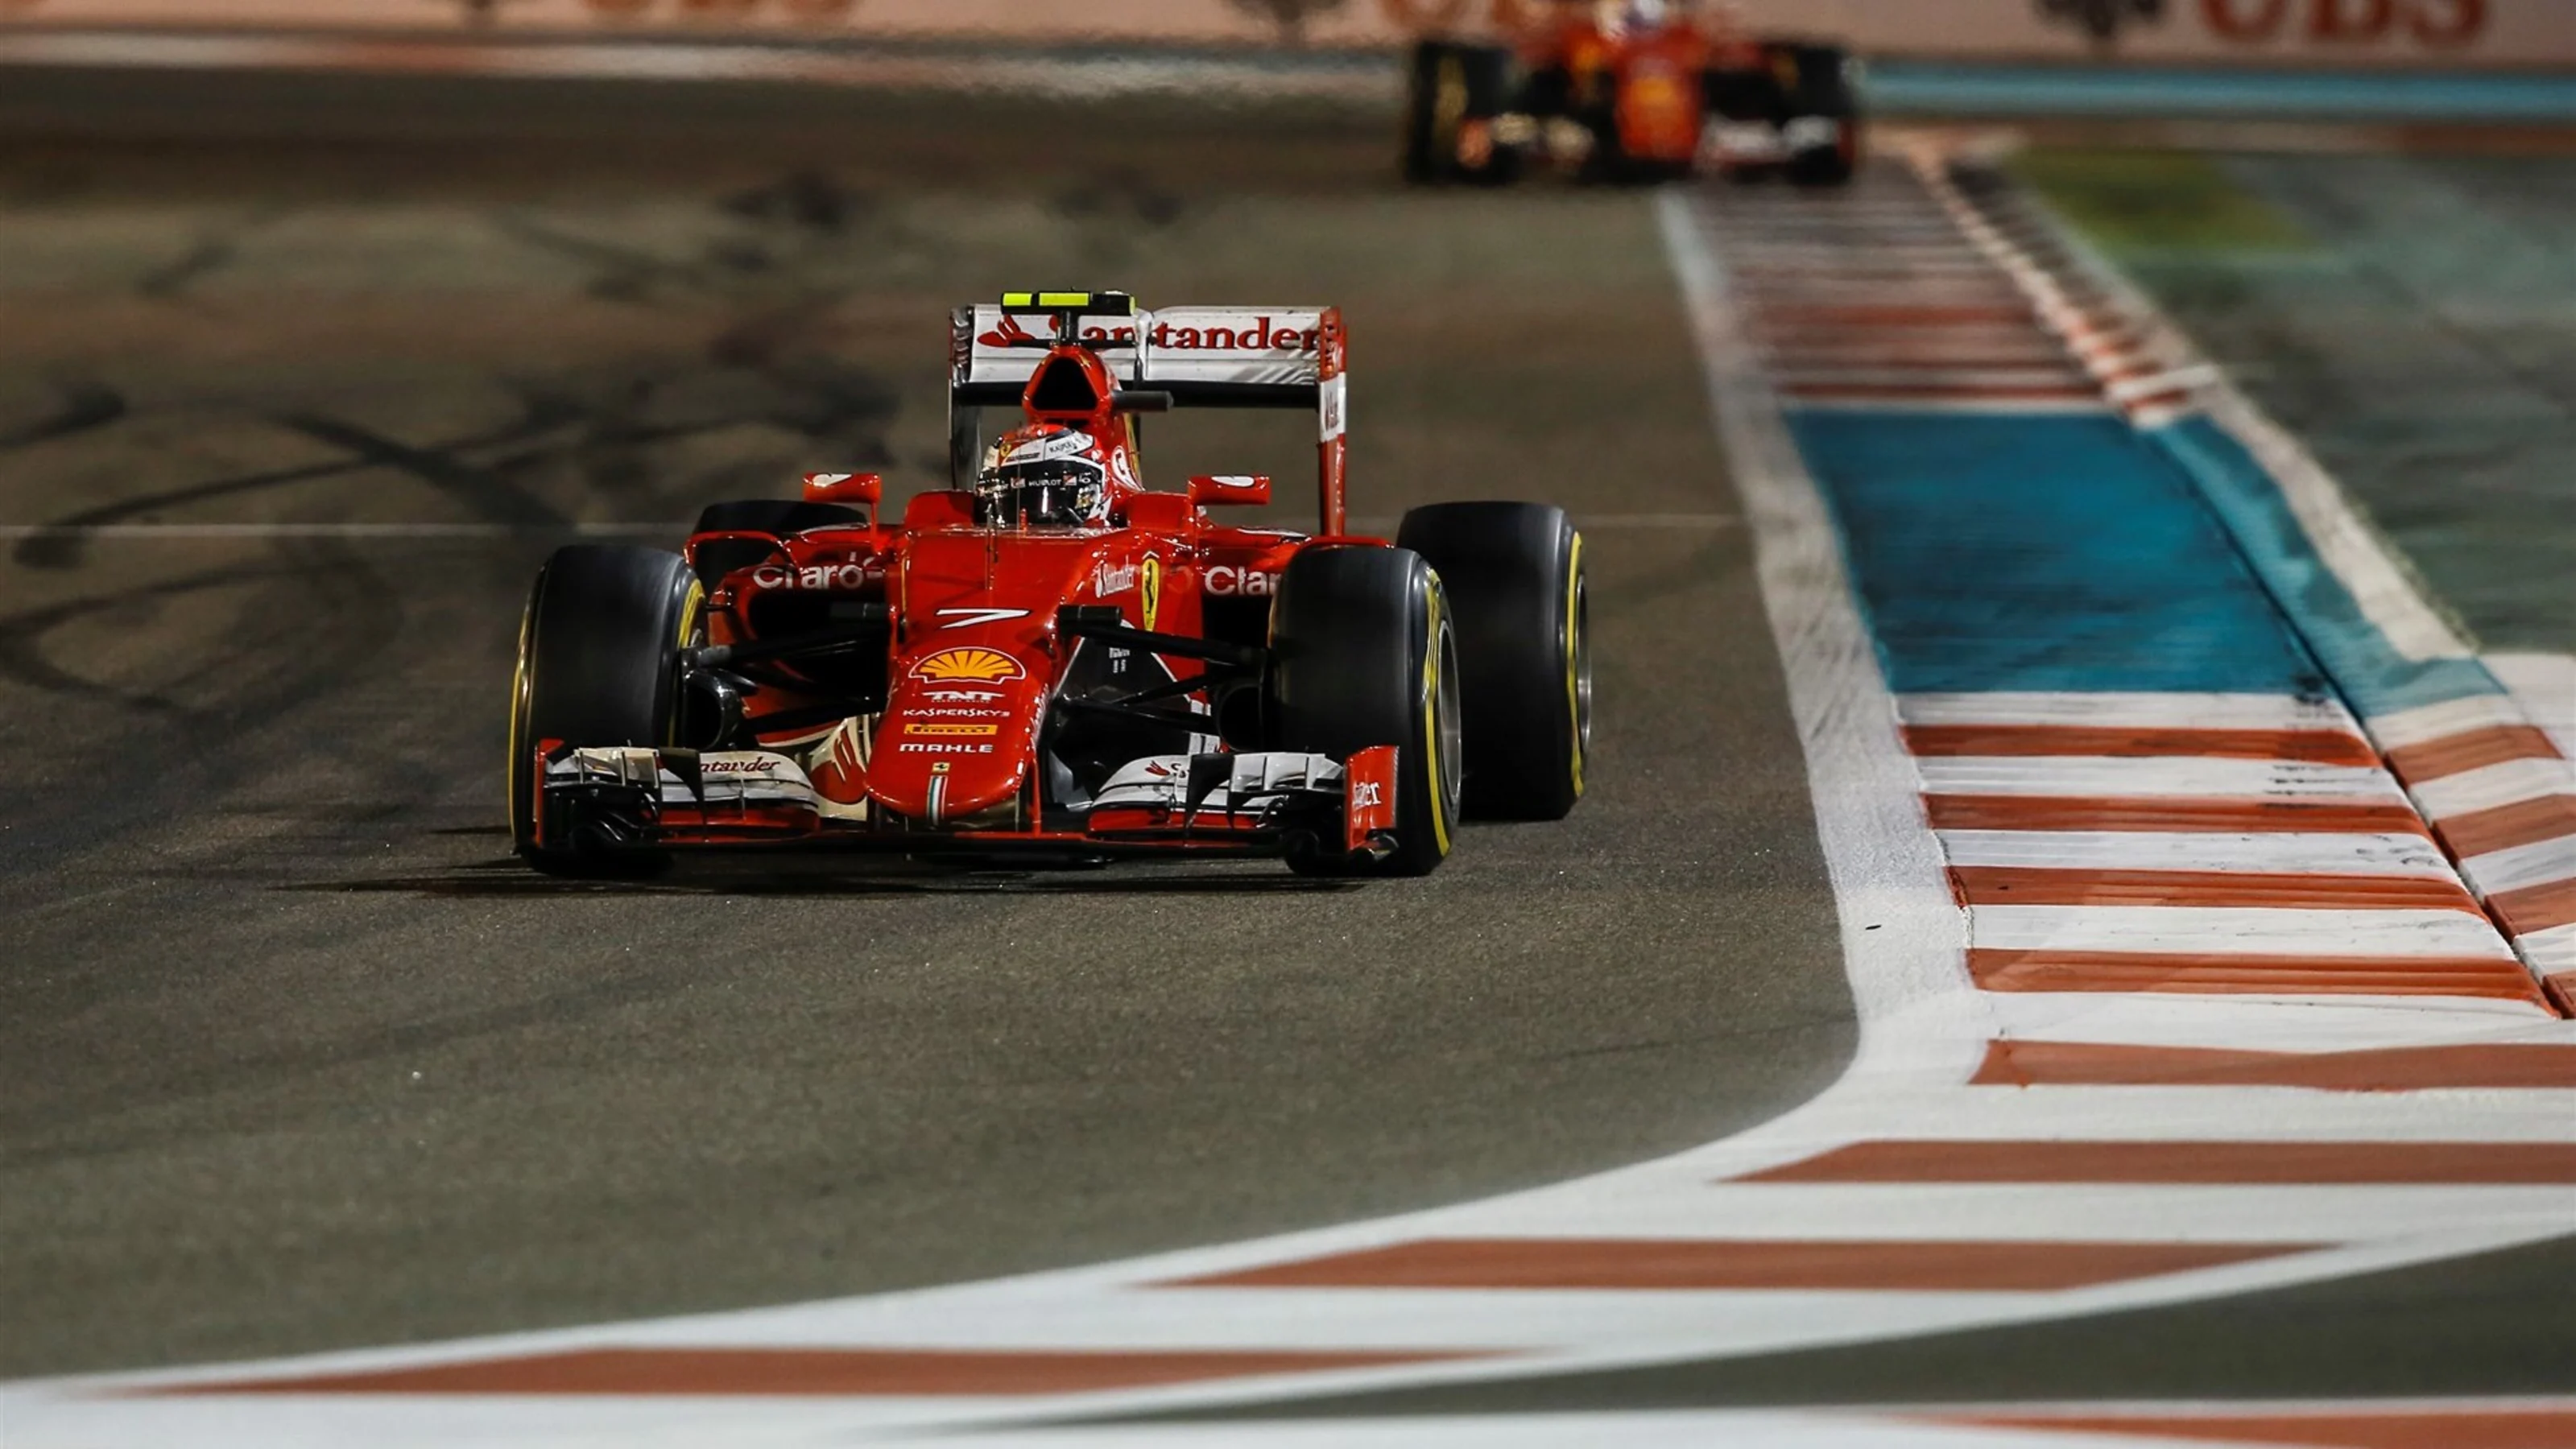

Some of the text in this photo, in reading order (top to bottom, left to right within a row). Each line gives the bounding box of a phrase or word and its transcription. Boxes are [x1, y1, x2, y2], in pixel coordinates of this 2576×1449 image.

[1049, 315, 1321, 349] antander
[1205, 565, 1281, 596] Clar
[936, 608, 1032, 630] 7
[922, 691, 1005, 700] TNT
[903, 708, 1000, 717] KASPERSKY
[899, 743, 993, 753] MAHLE
[701, 756, 780, 773] ntander
